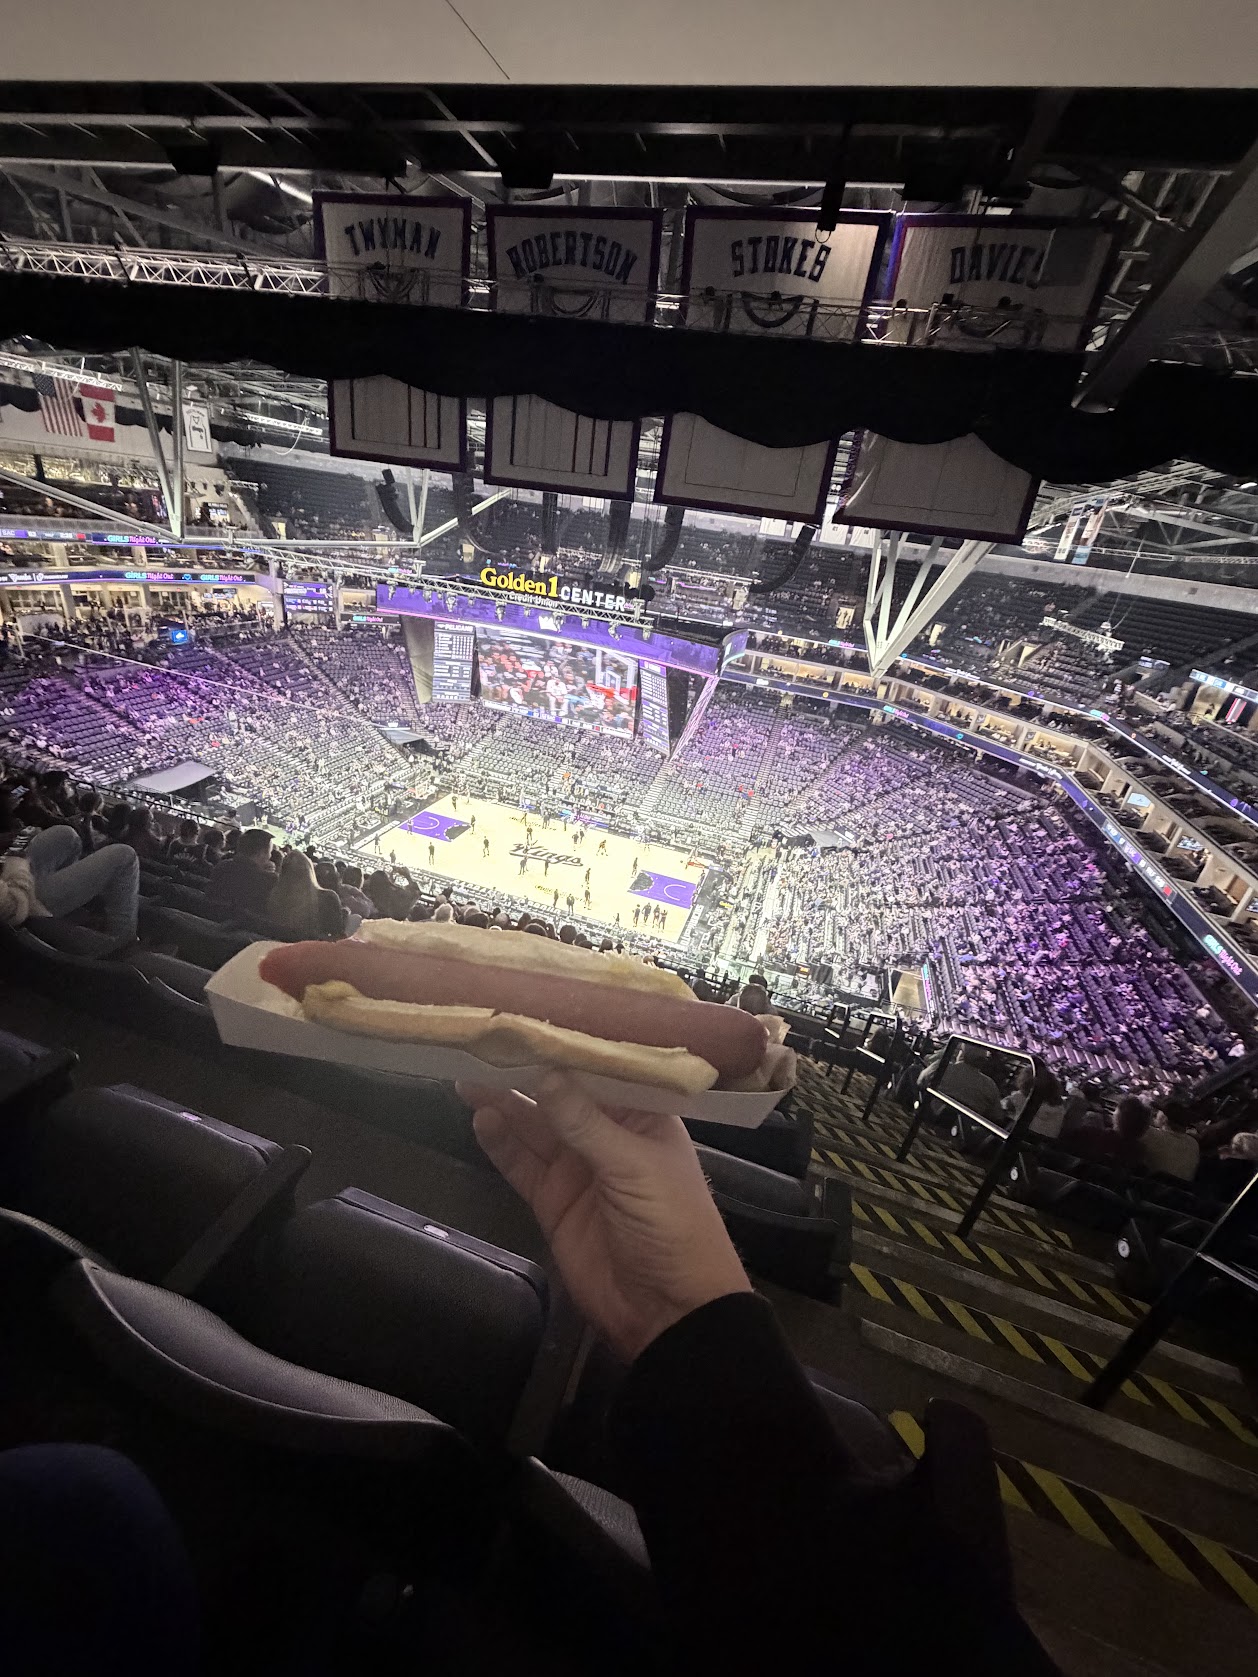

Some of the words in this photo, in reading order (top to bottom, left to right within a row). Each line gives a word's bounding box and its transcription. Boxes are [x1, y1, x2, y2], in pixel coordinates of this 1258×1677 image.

[344, 217, 441, 260] TWYMAN
[506, 230, 638, 285] ROBERTSON
[731, 235, 832, 283] STOKES
[107, 535, 129, 543] GIRLS
[125, 571, 147, 579] GIRLS
[509, 591, 533, 604] Credit
[560, 586, 625, 612] CENTER
